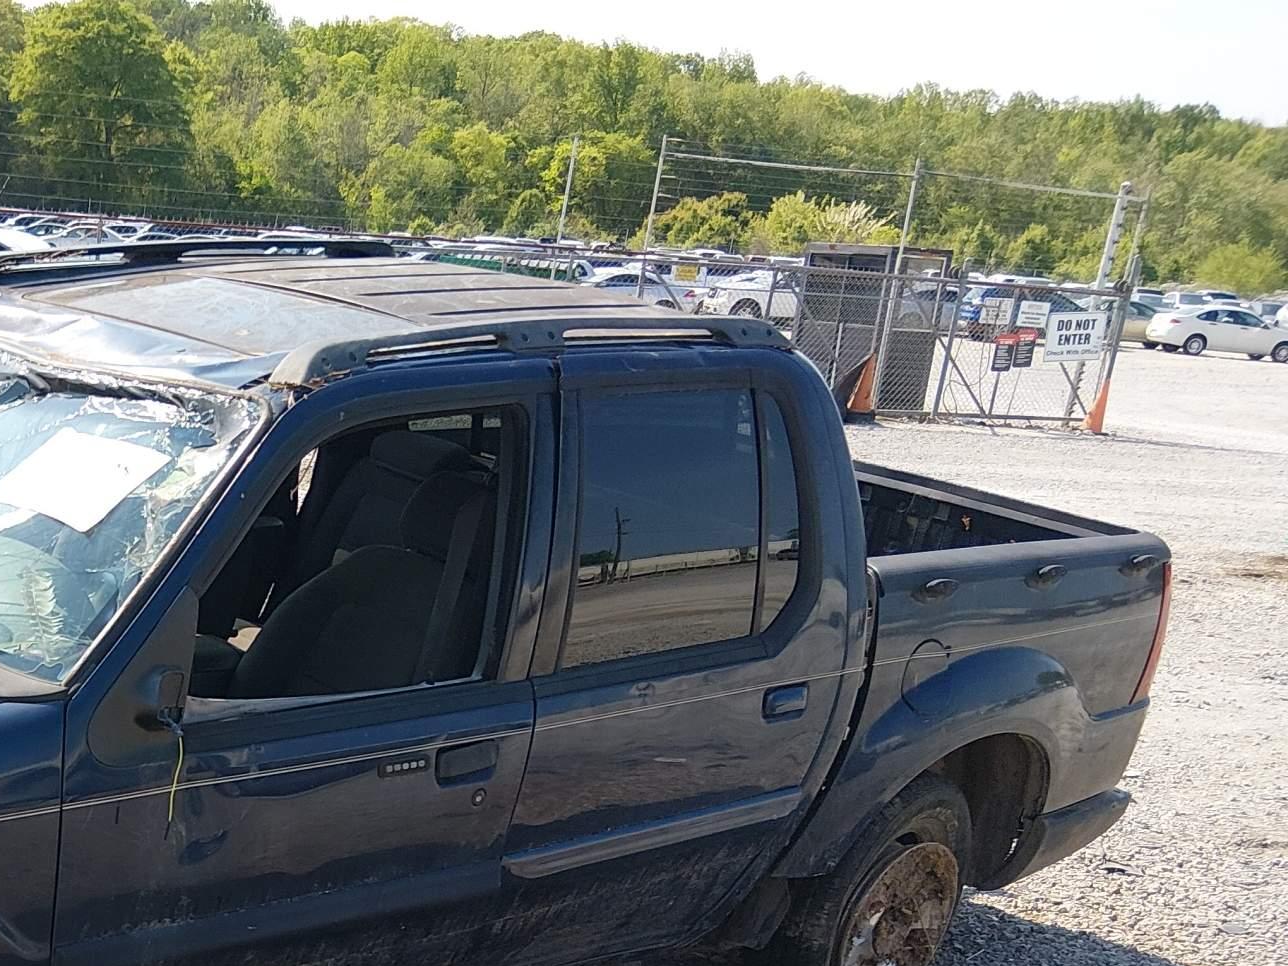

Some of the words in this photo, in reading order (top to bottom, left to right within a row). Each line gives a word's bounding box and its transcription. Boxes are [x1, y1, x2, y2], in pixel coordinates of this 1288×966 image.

[1057, 319, 1073, 331] DO
[1075, 318, 1098, 331] NOT
[1057, 333, 1092, 346] ENTER
